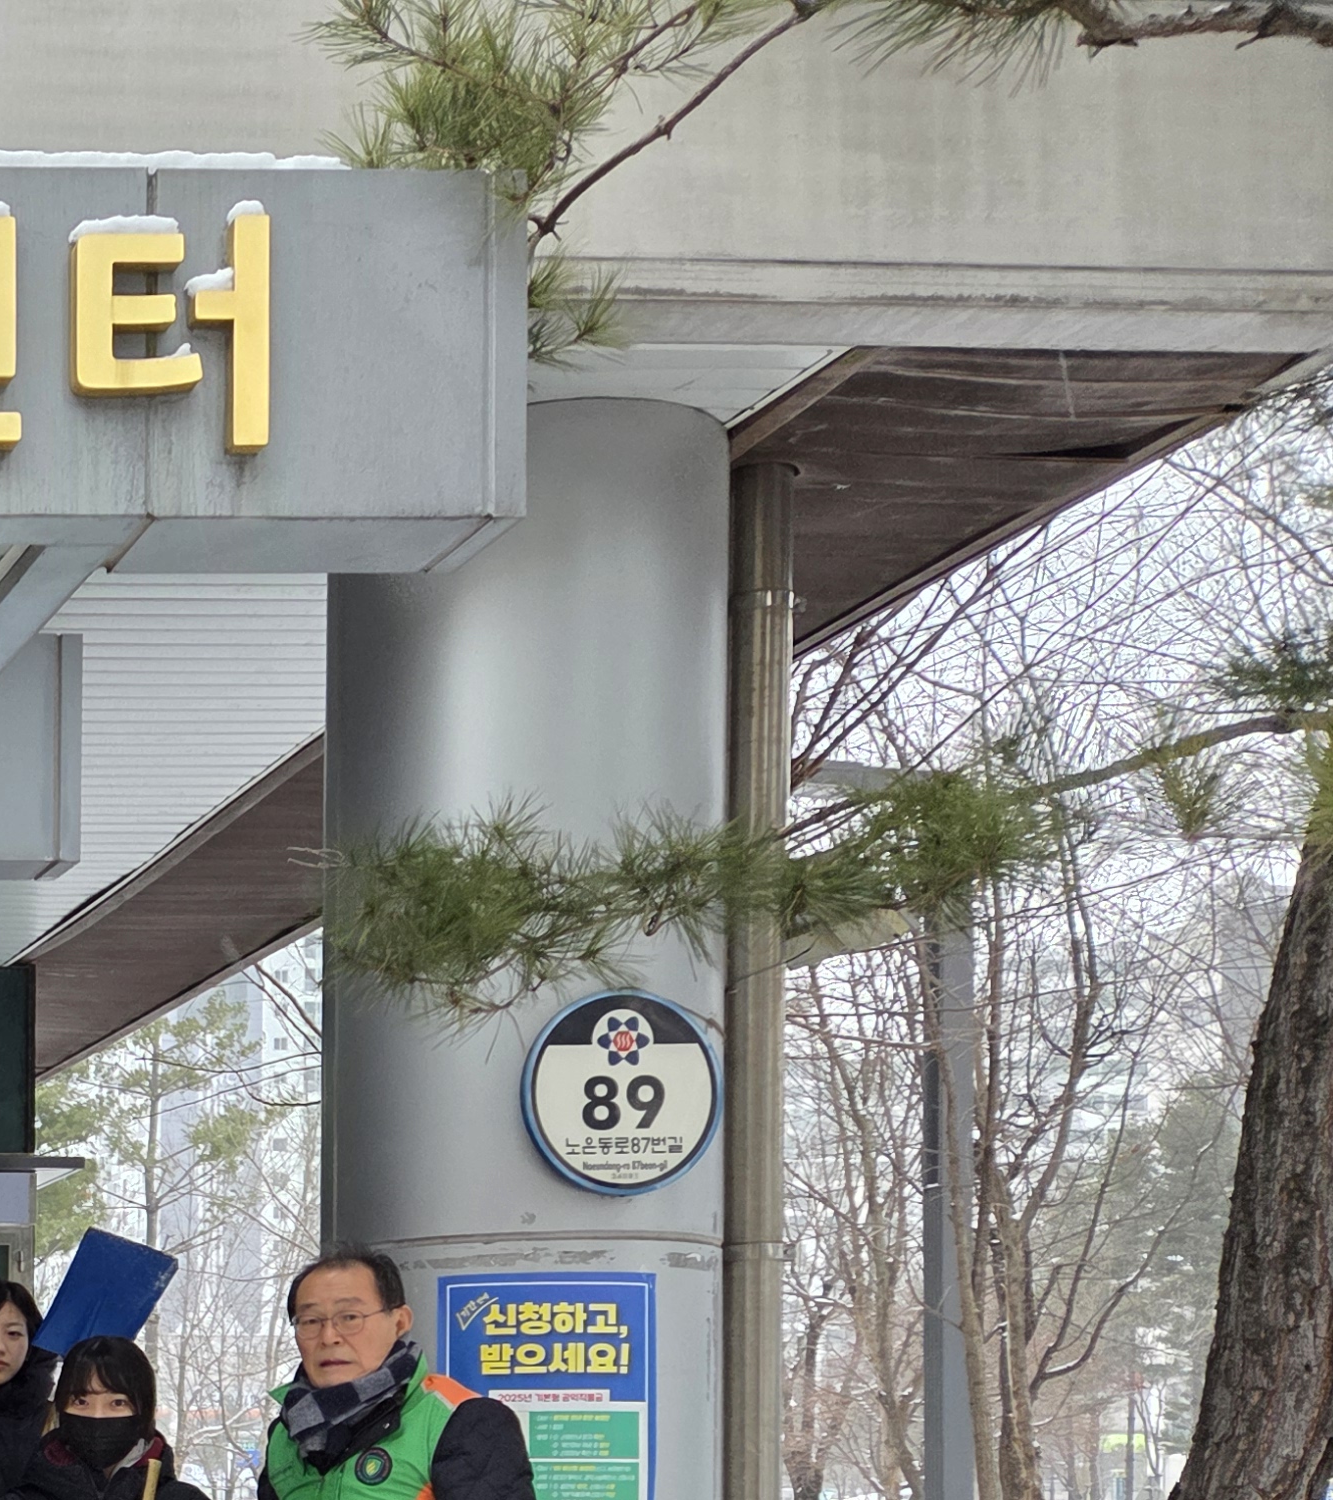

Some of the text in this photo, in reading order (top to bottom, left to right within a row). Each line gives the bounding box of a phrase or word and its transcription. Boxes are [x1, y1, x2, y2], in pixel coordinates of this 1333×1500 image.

[582, 1074, 666, 1131] 89
[565, 1136, 684, 1156] 노은동로87번길
[483, 1301, 629, 1339] 신청하고,
[479, 1342, 630, 1376] 받으세요!
